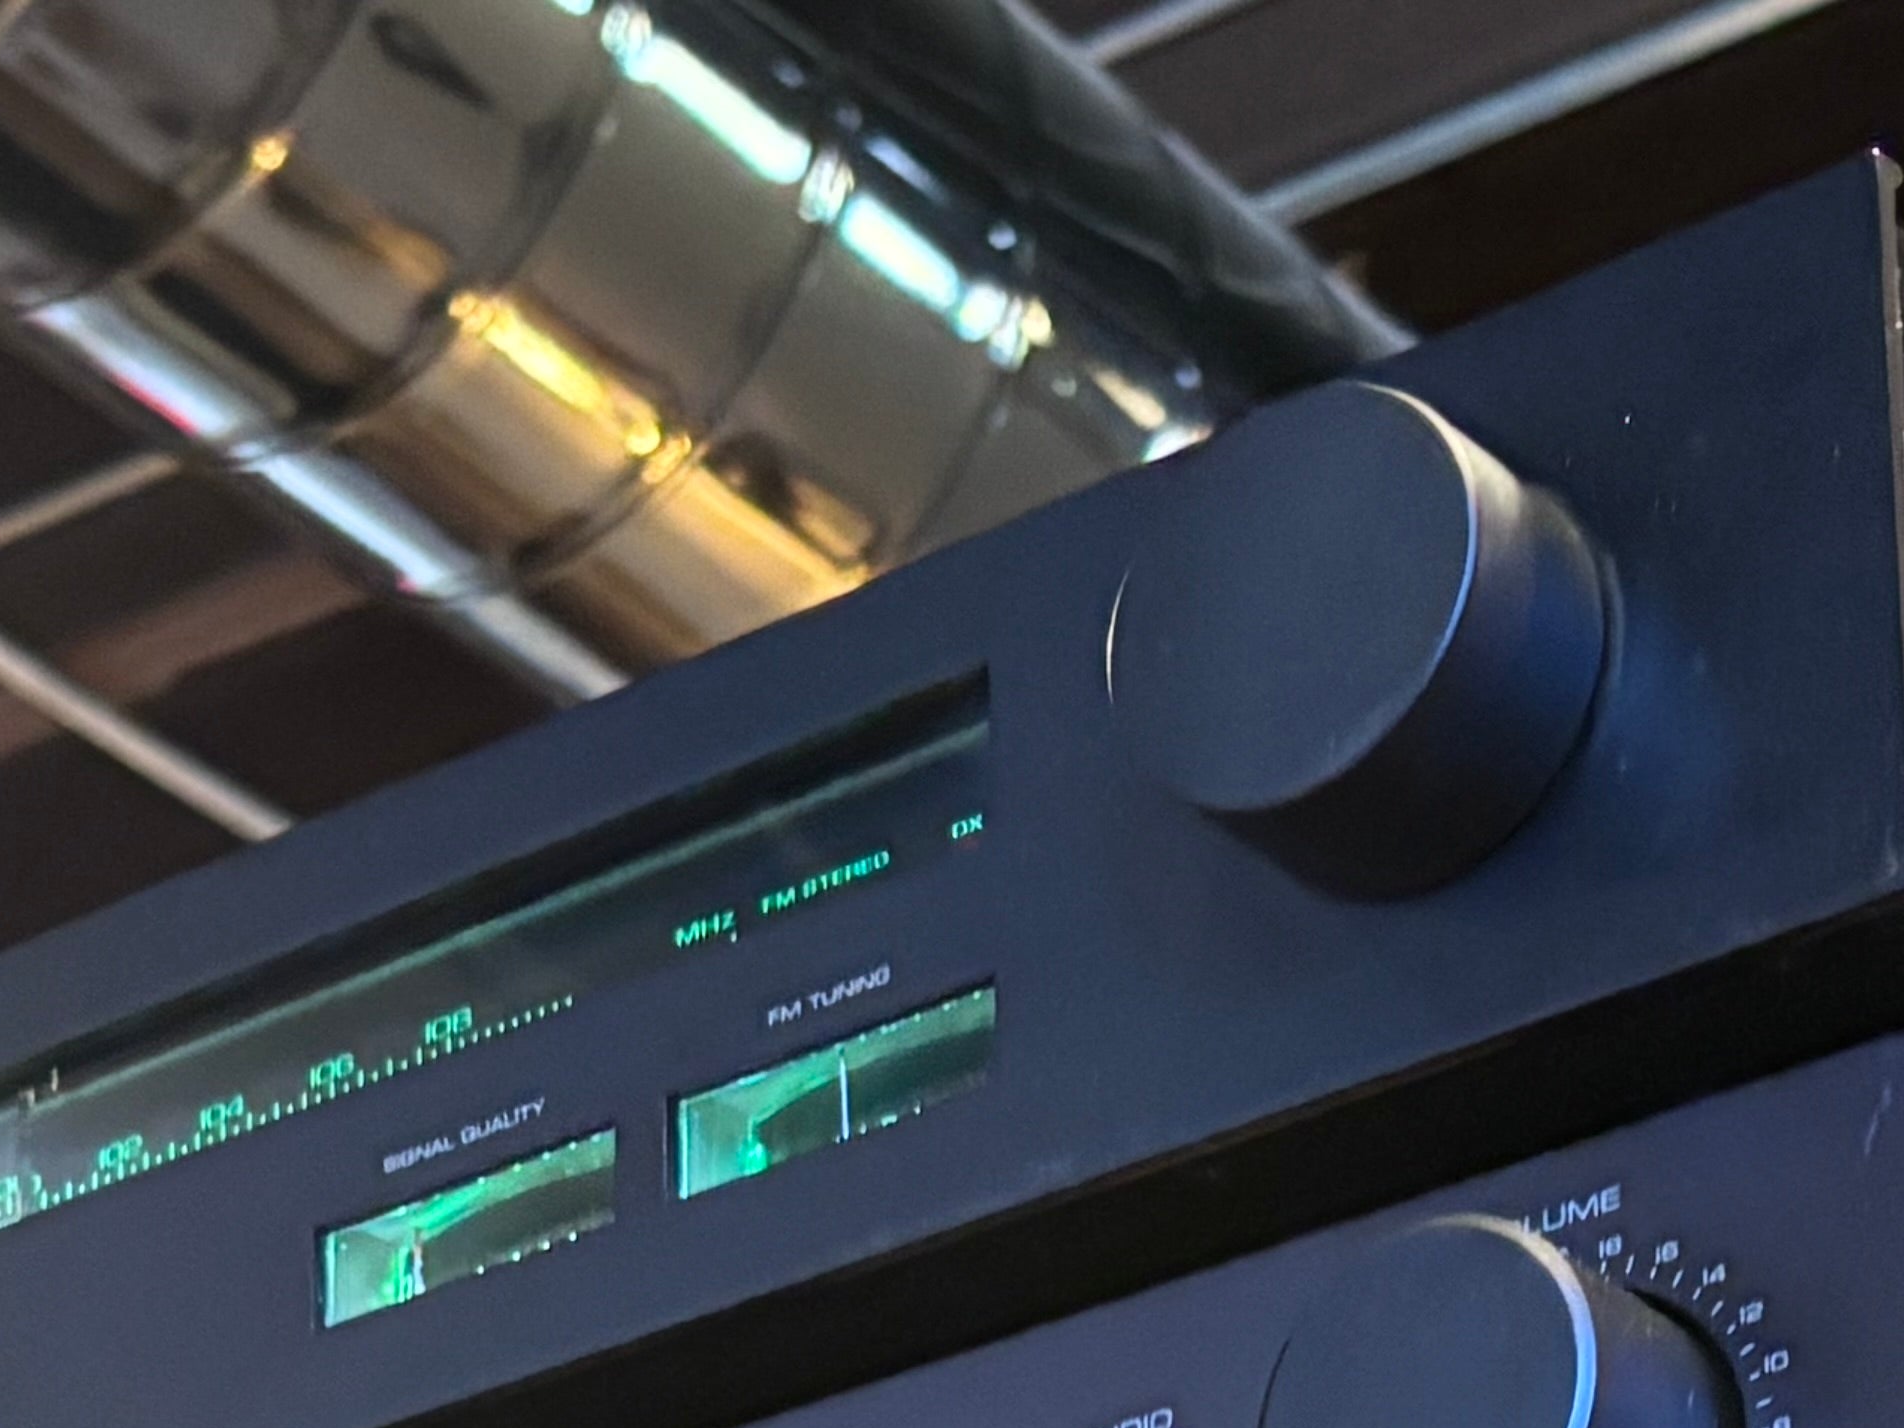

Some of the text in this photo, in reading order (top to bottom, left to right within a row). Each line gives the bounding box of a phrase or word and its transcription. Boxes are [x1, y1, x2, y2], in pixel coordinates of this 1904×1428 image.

[951, 814, 984, 840] DX
[762, 850, 891, 916] FM STEREO
[675, 910, 737, 950] MHz
[766, 963, 892, 1030] FM TUNING
[99, 1134, 143, 1170] 102
[200, 1095, 244, 1131] 104
[310, 1052, 354, 1089] 106
[424, 1006, 472, 1046] 108
[383, 1097, 546, 1175] SIGNAL QUALITY
[1517, 1184, 1622, 1236] LUME
[1703, 1263, 1727, 1287] 14
[1763, 1349, 1791, 1375] 10
